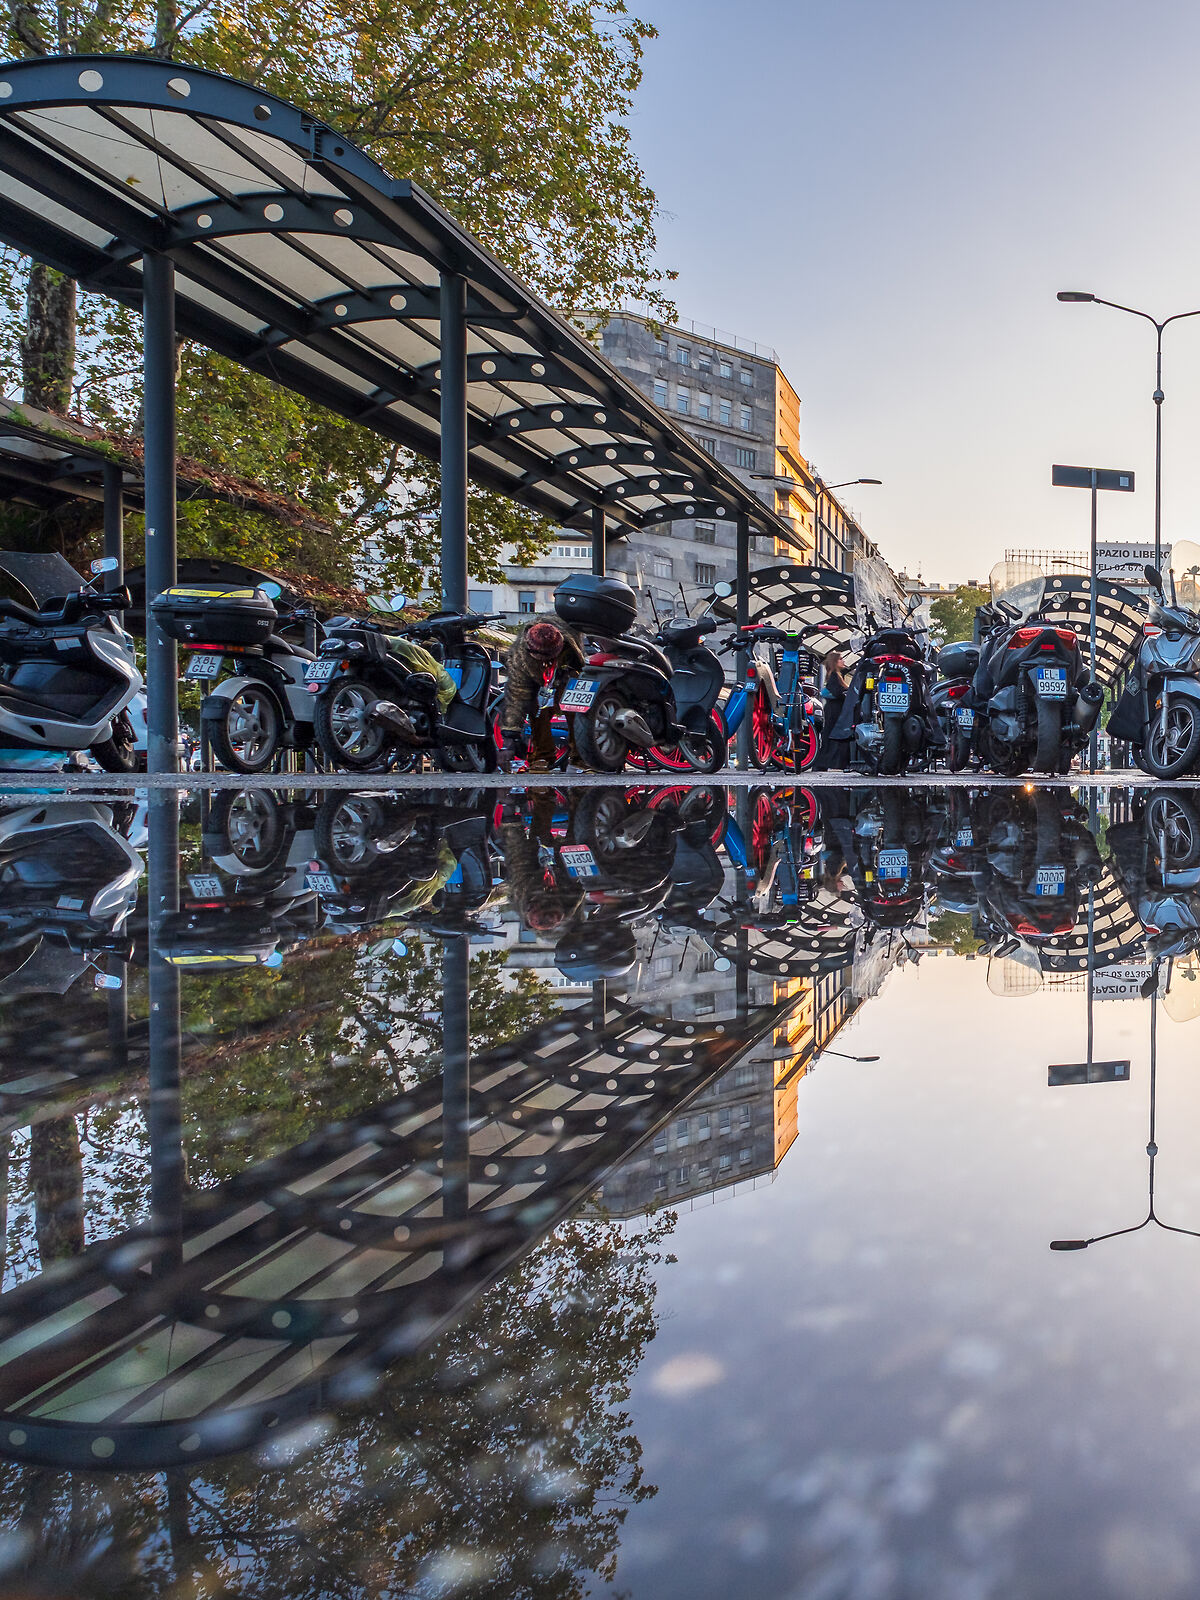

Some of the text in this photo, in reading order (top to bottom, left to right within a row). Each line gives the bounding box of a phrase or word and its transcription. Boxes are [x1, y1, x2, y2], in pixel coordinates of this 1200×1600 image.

[194, 656, 217, 665] X8L
[191, 664, 215, 673] GLG
[312, 662, 332, 670] X9C
[309, 670, 329, 678] 3LN
[1039, 681, 1066, 692] 99592
[563, 691, 593, 704] 21928
[880, 694, 908, 705] 53023
